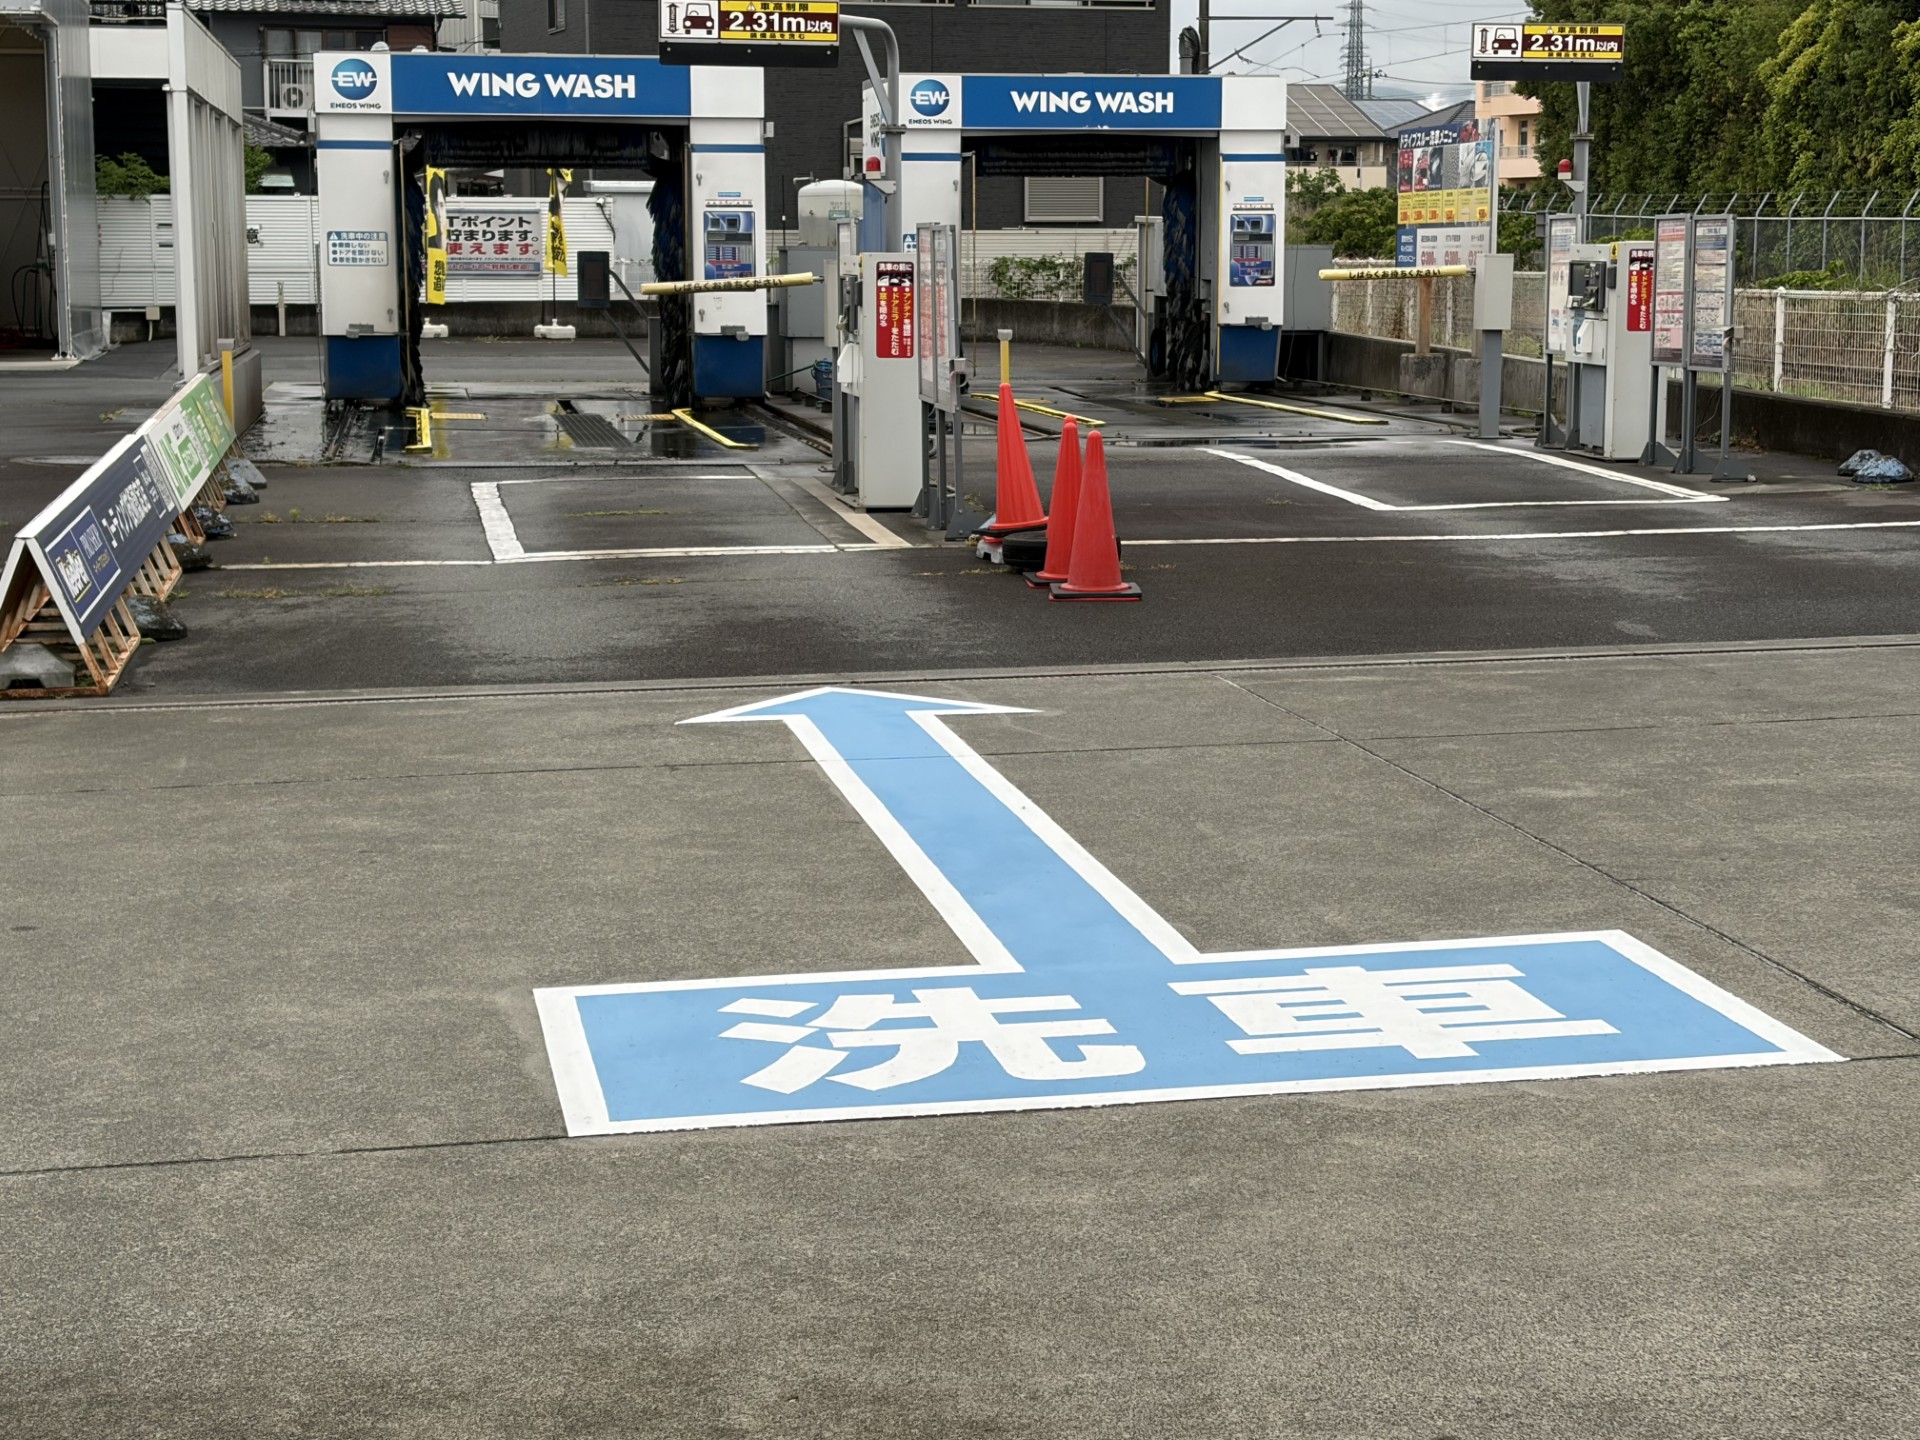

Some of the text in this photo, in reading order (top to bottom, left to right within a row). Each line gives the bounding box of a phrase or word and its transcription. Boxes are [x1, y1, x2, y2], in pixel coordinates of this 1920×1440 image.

[728, 12, 832, 33] 2.31m以内
[1530, 35, 1617, 51] 2.31m以内
[337, 72, 373, 87] EW
[446, 72, 636, 98] WING WASH
[915, 91, 946, 105] EW
[1010, 90, 1174, 113] WING WASH
[446, 215, 532, 228] Tポイント
[340, 232, 386, 240] 洗車中の注意
[446, 229, 538, 242] 貯まります。
[878, 263, 913, 271] 洗車の前に
[1349, 269, 1442, 279] しばらくお待ちください
[673, 279, 783, 292] しばらくお待ちください
[891, 292, 899, 355] ドアミラーをたたむ
[717, 964, 1622, 1094] 洗車
